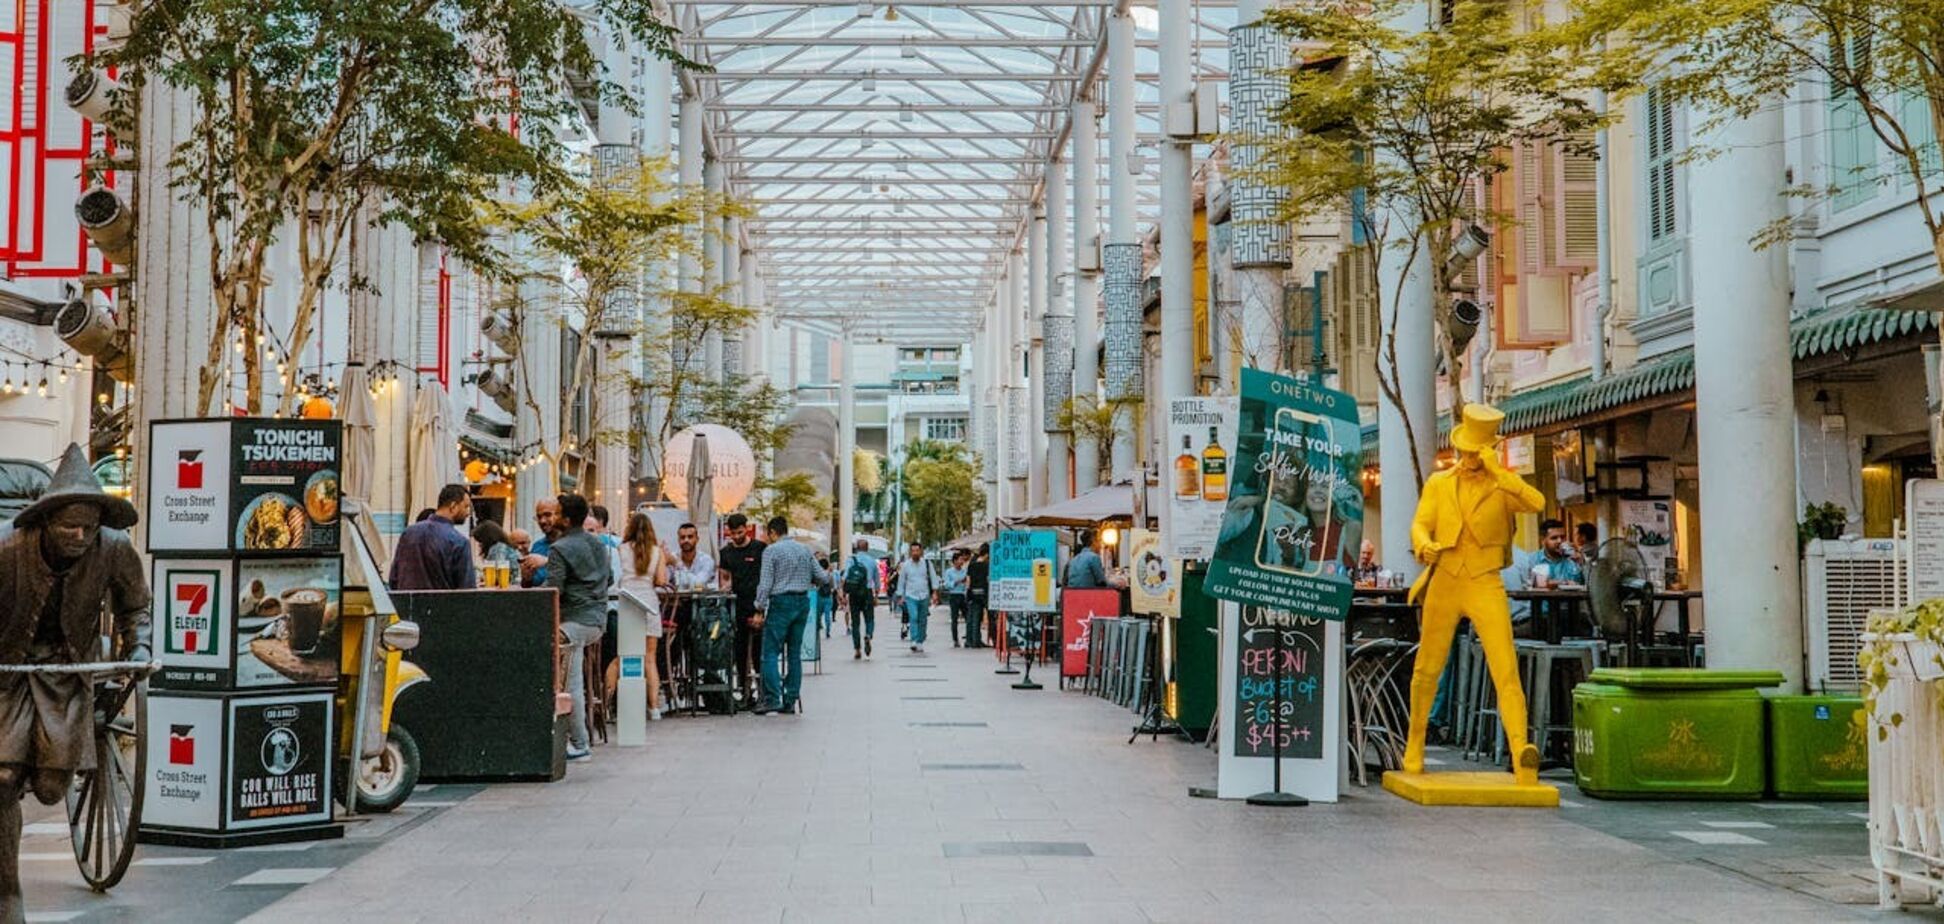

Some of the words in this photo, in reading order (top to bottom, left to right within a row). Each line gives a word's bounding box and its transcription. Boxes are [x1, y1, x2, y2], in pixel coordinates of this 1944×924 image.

[1271, 381, 1336, 408] ONETWO
[1172, 401, 1204, 413] BOTTLE
[1172, 413, 1224, 425] PROMOTION
[254, 429, 324, 446] TONICHI
[1264, 428, 1302, 448] TAKE
[1305, 437, 1343, 457] YOUR
[241, 445, 335, 461] TSUKEMEN
[164, 495, 188, 507] Cross
[189, 495, 216, 507] Street
[168, 511, 209, 524] Exchange
[1002, 532, 1032, 546] PUNK
[1274, 519, 1317, 549] Photo
[1002, 546, 1047, 560] O'CLOCK
[1229, 566, 1259, 579] UPLOAD
[1259, 571, 1270, 580] TO
[1270, 574, 1292, 585] YOUR
[1230, 588, 1253, 599] YOUR
[1298, 675, 1318, 704] of
[1255, 700, 1270, 723] 6
[1280, 701, 1295, 715] @
[156, 769, 180, 781] Cross
[181, 771, 207, 784] Street
[242, 778, 261, 793] COQ
[265, 776, 290, 791] WILL
[294, 773, 317, 788] RISE
[160, 785, 201, 802] Exchange
[240, 792, 269, 808] BALLS
[271, 790, 293, 805] WILL
[295, 788, 317, 802] ROLL
